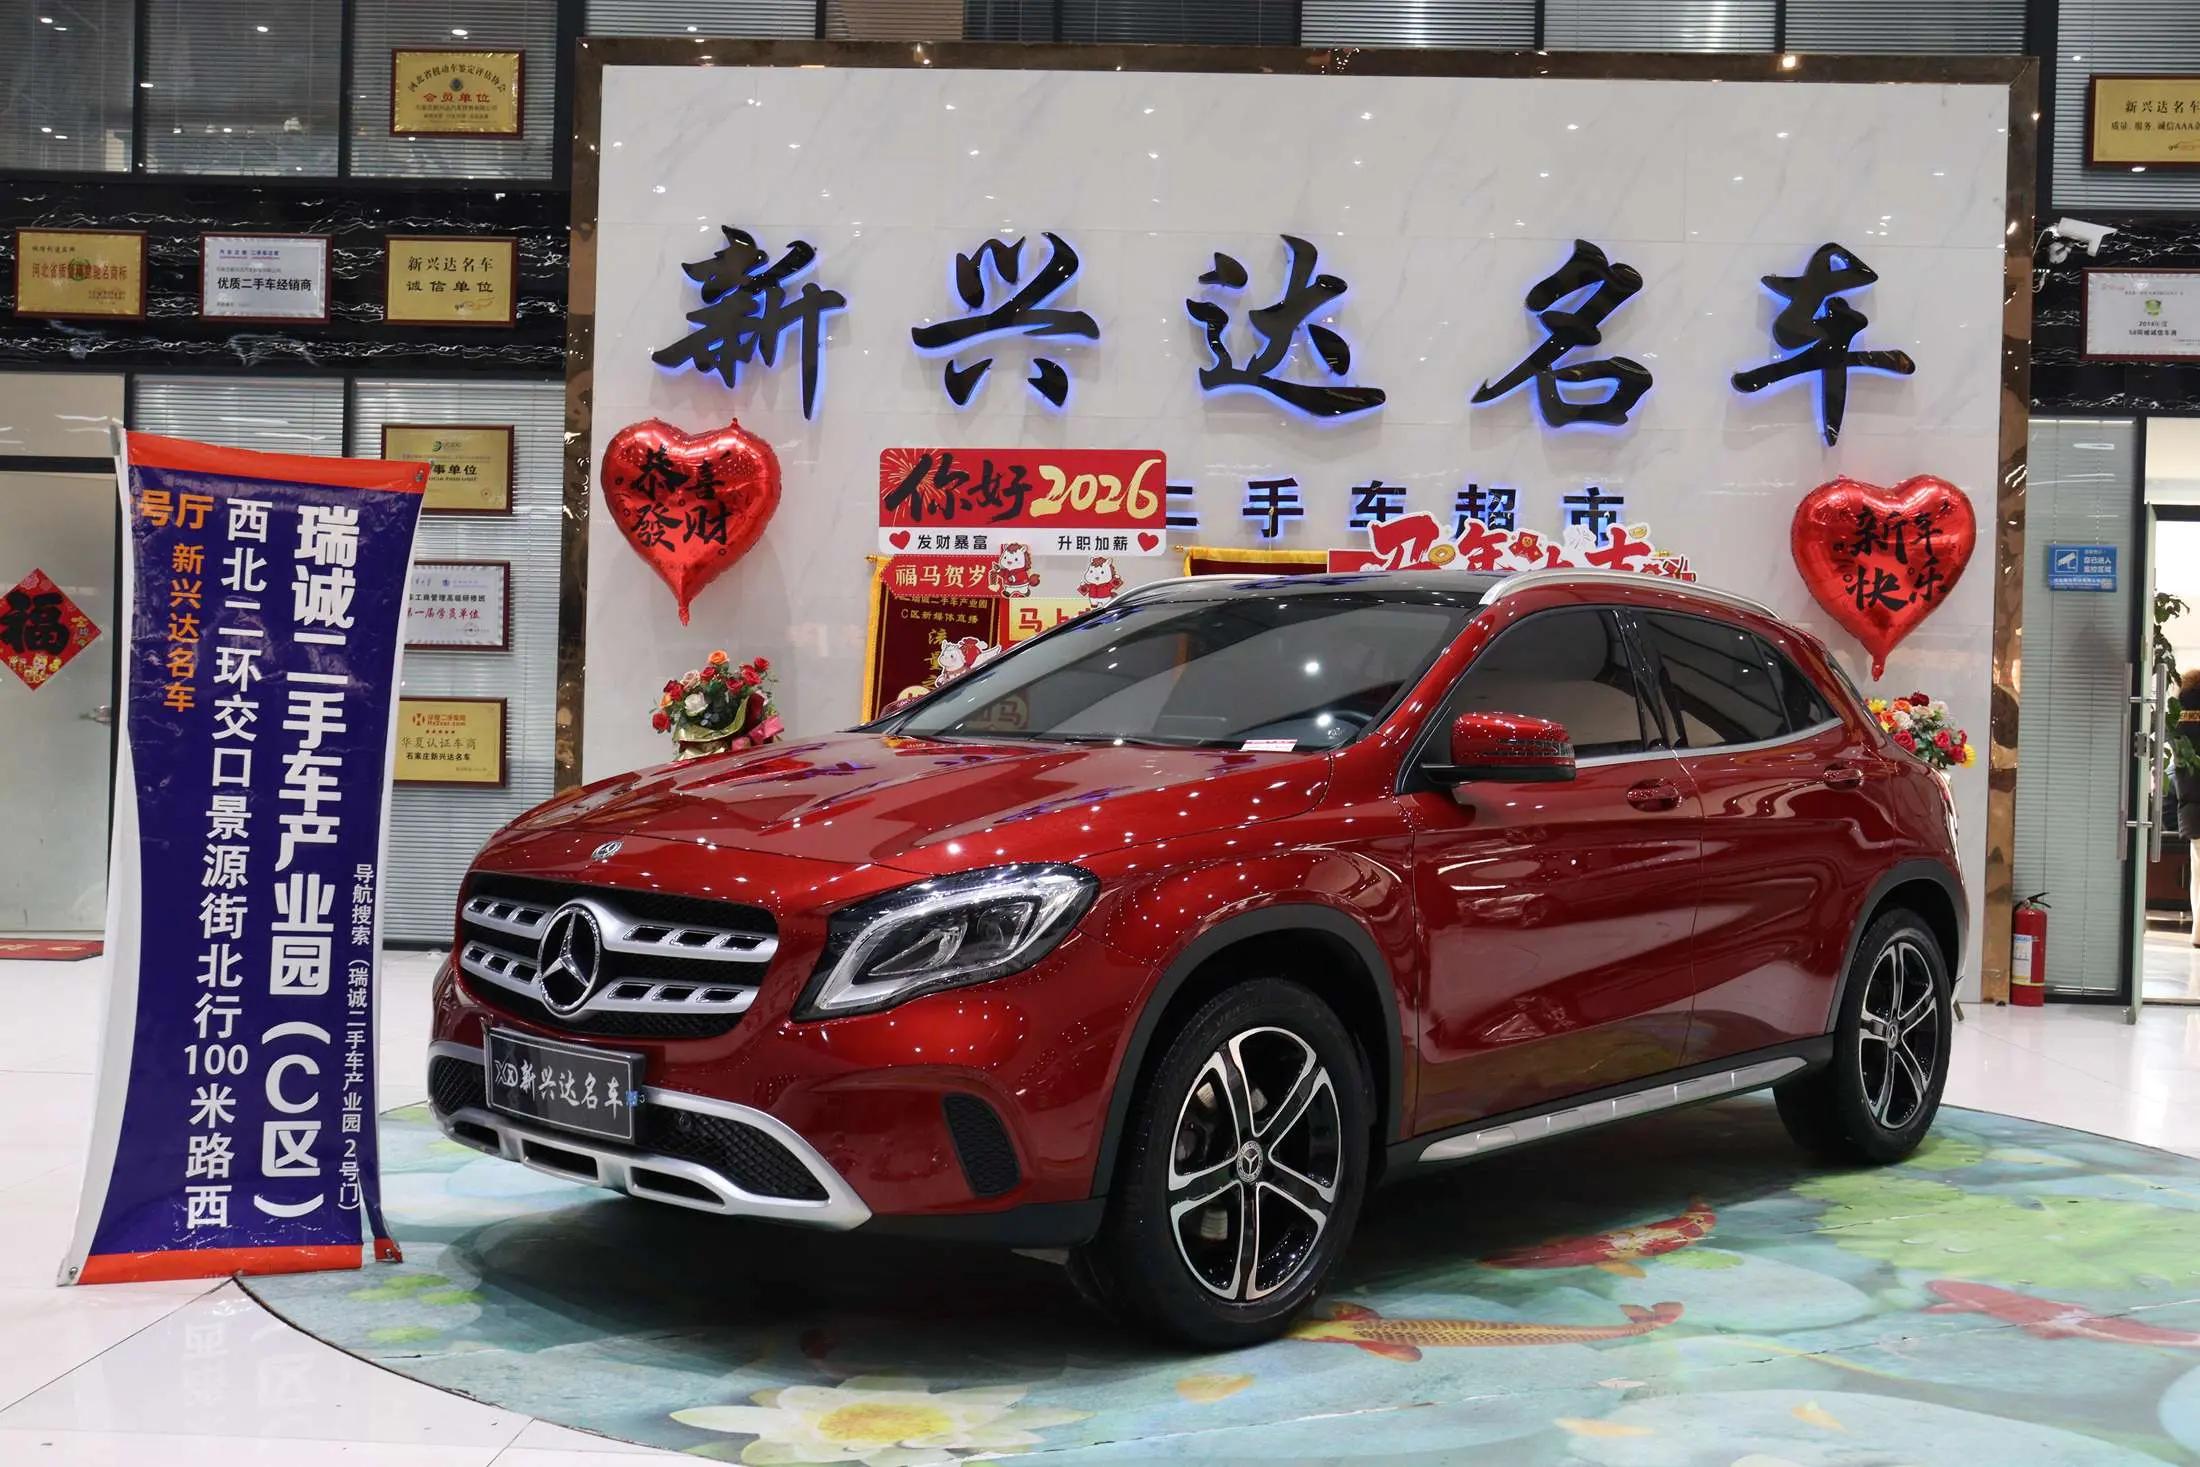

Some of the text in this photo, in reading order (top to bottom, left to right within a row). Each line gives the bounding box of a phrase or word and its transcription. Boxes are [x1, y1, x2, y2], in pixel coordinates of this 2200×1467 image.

[407, 255, 494, 273] 新兴达名车
[217, 277, 312, 292] 优质二手车经销商
[406, 280, 494, 294] 诚信单位
[651, 224, 1916, 447] 新兴达名车
[884, 452, 1162, 524] 你好 2026
[917, 534, 989, 551] 发财暴富
[1057, 535, 1129, 552] 升职加薪
[1849, 504, 1944, 565] 新年
[895, 564, 986, 589] 福马贺岁
[1844, 556, 1949, 612] 快乐
[0, 591, 70, 655] 福
[163, 543, 206, 713] 新兴达名车
[401, 736, 478, 750] 华夏认证车商
[519, 1058, 624, 1121] 新兴达名车
